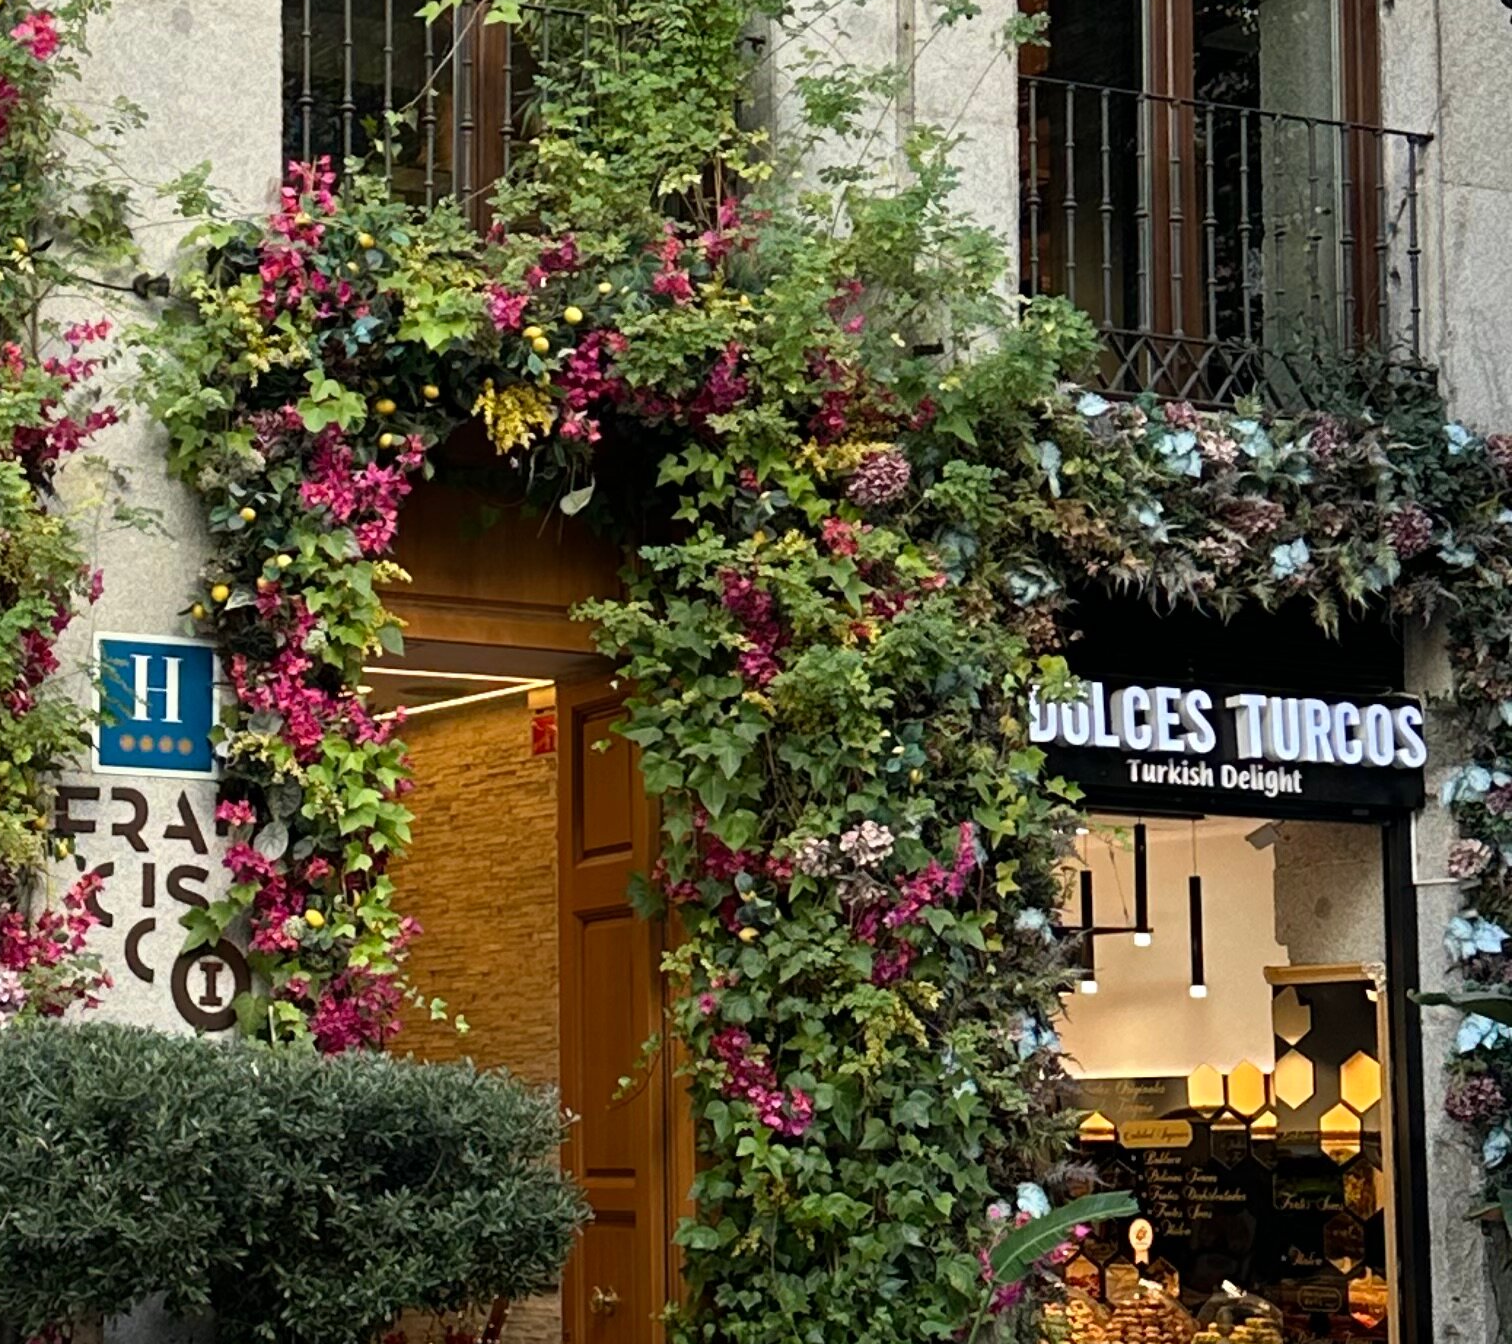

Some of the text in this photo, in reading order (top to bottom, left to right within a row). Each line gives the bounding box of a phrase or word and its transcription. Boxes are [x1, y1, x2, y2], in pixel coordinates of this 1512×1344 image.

[130, 654, 183, 723] H
[1029, 681, 1427, 769] DULCES TURCOS
[1126, 757, 1303, 799] Turkish Delight
[55, 786, 228, 854] FRA
